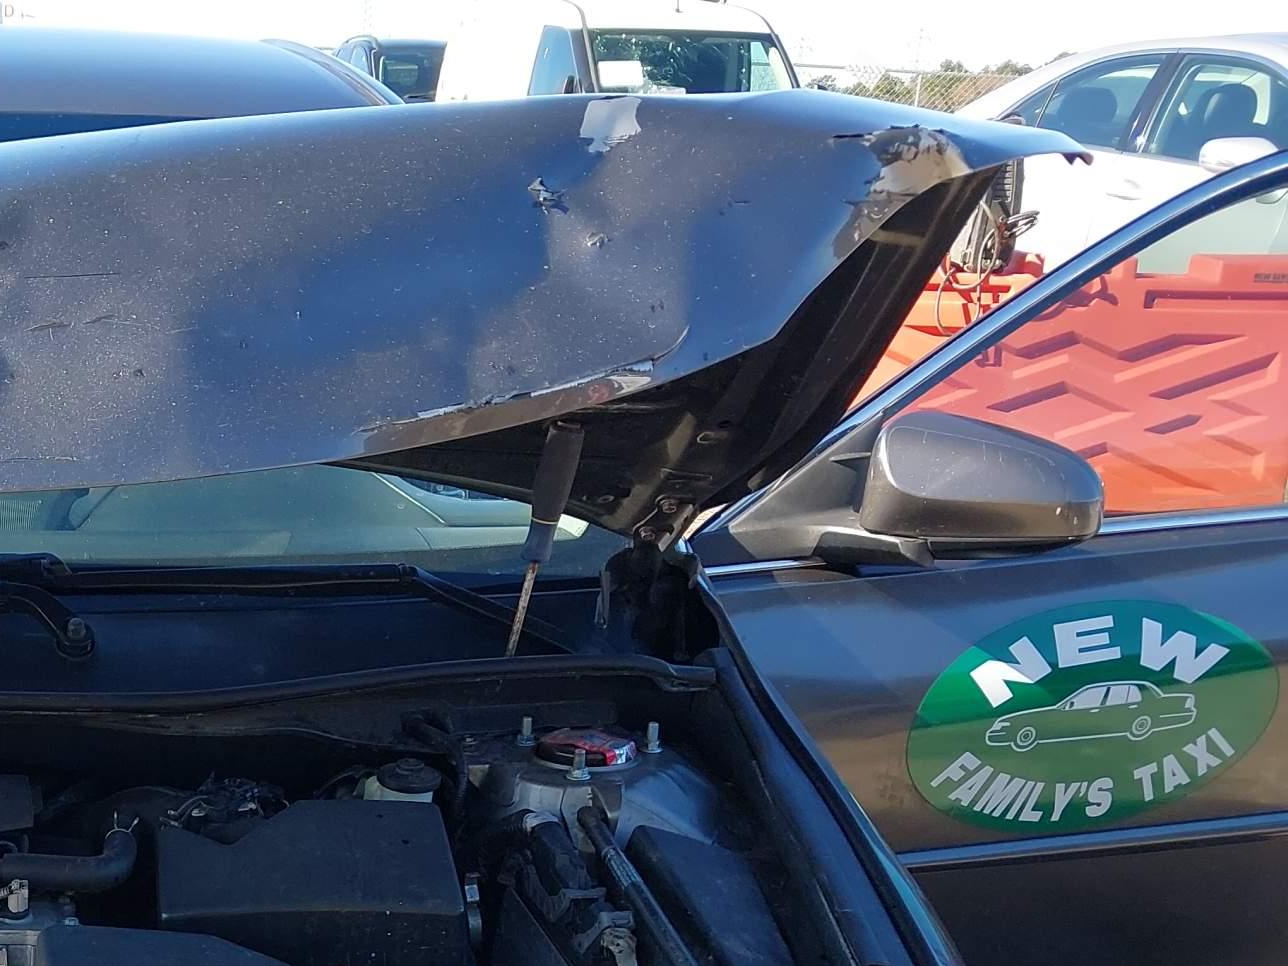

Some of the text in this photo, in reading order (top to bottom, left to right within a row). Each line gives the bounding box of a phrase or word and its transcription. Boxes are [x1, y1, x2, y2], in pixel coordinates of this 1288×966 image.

[969, 614, 1231, 708] NEW
[930, 727, 1236, 822] FAMILY'S TAXI
